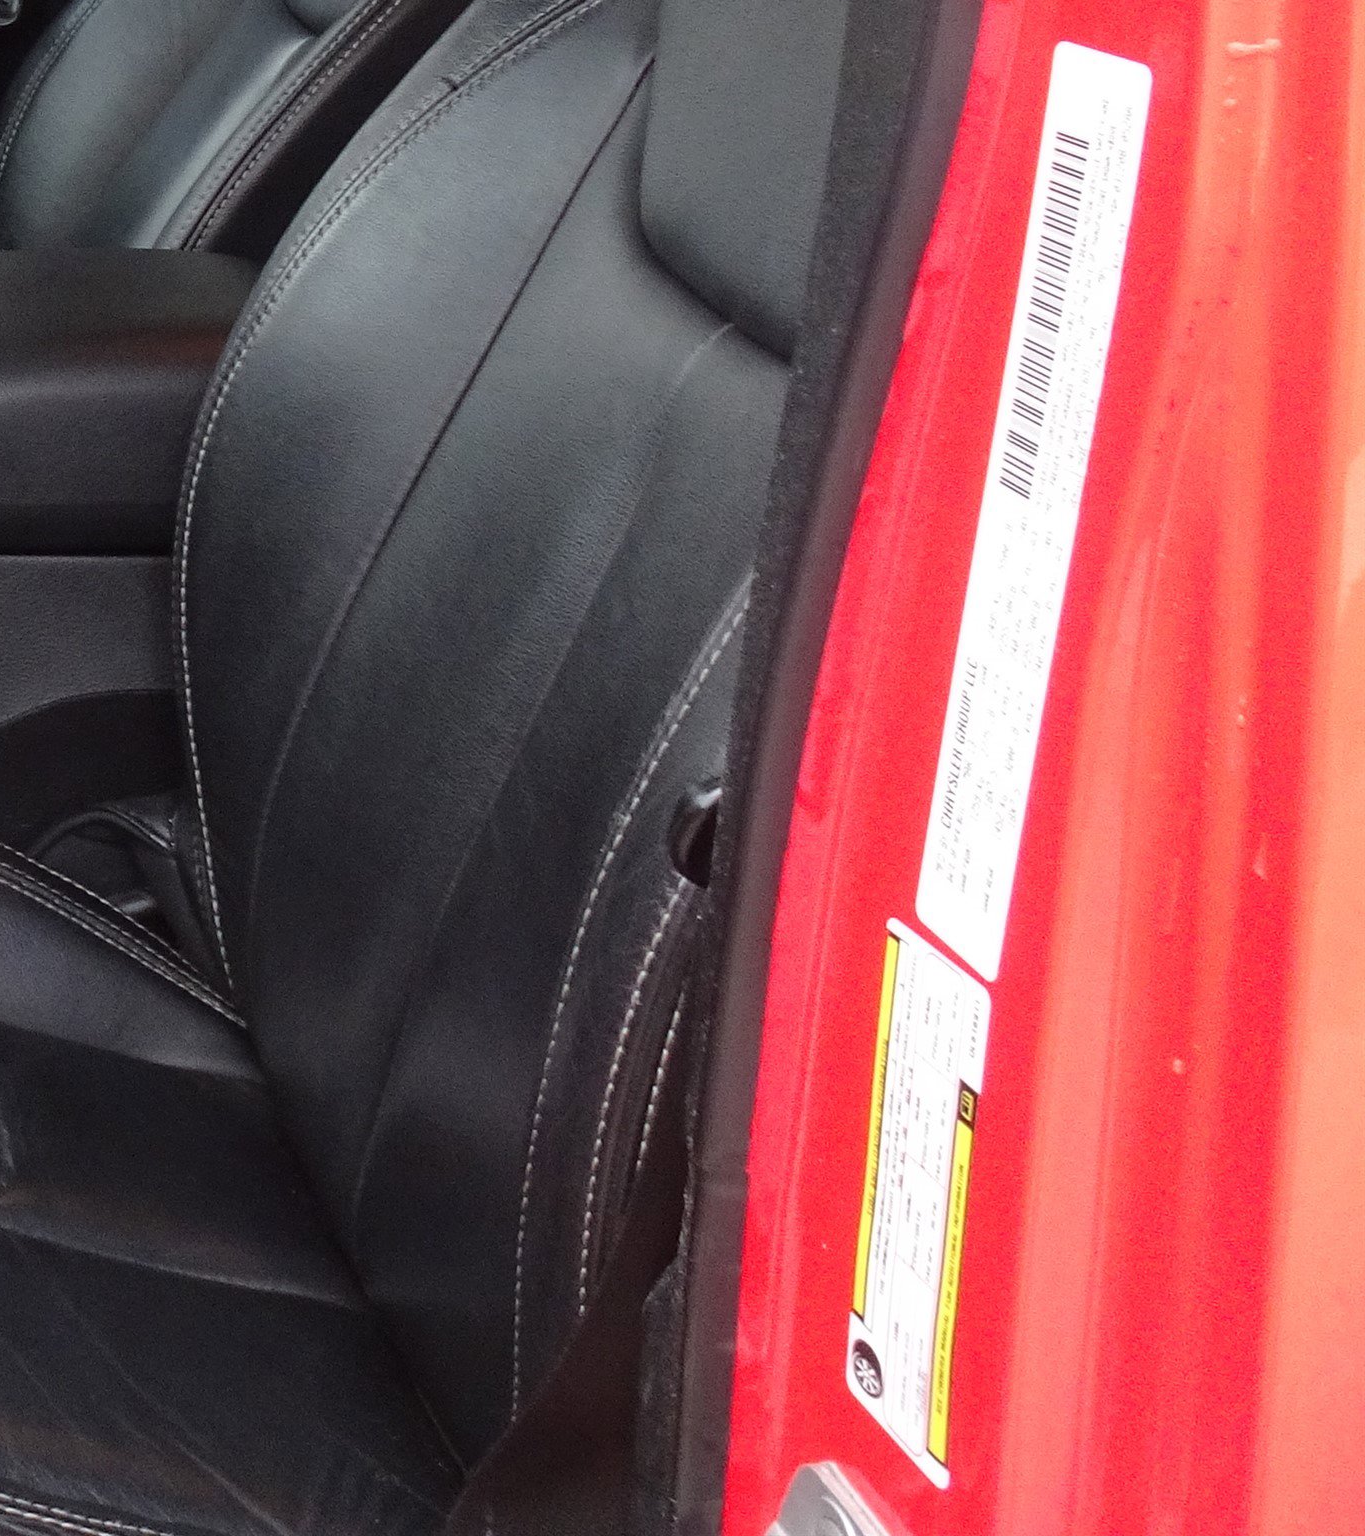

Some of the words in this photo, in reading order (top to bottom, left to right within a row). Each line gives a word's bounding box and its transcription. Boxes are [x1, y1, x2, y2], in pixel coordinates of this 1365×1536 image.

[943, 744, 963, 831] CHRYSLER
[955, 689, 973, 746] GROUP
[964, 656, 978, 689] LLC
